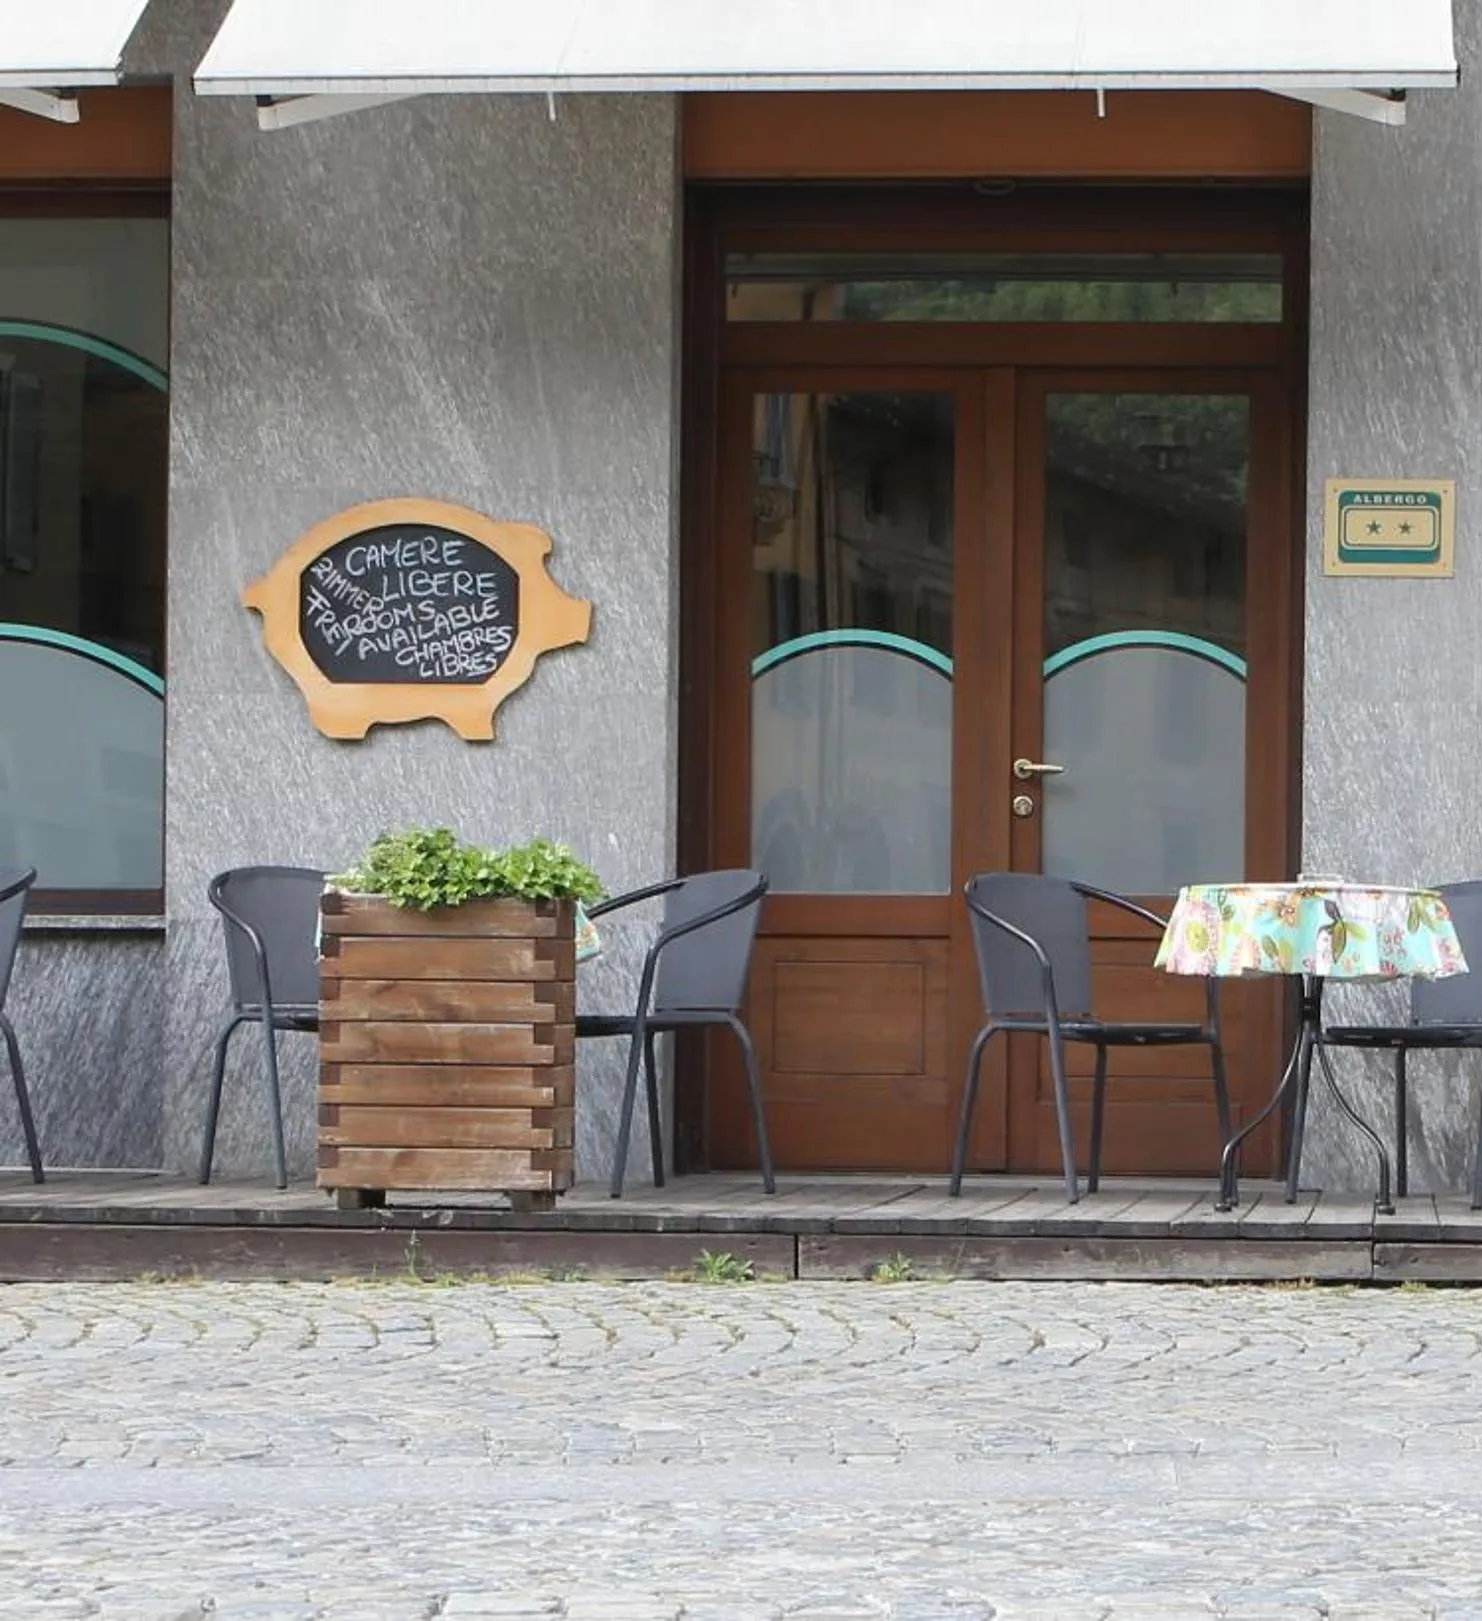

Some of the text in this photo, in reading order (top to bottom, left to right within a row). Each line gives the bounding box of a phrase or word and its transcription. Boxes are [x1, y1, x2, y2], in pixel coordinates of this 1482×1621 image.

[1353, 494, 1427, 505] ALBERGO
[345, 536, 466, 577] CAMERE
[382, 568, 496, 602] LIBERE
[342, 599, 436, 636] ROOMS
[358, 596, 500, 661] AVAILABLE
[394, 626, 513, 666] CHAMBRES
[419, 650, 499, 678] LIBRES
